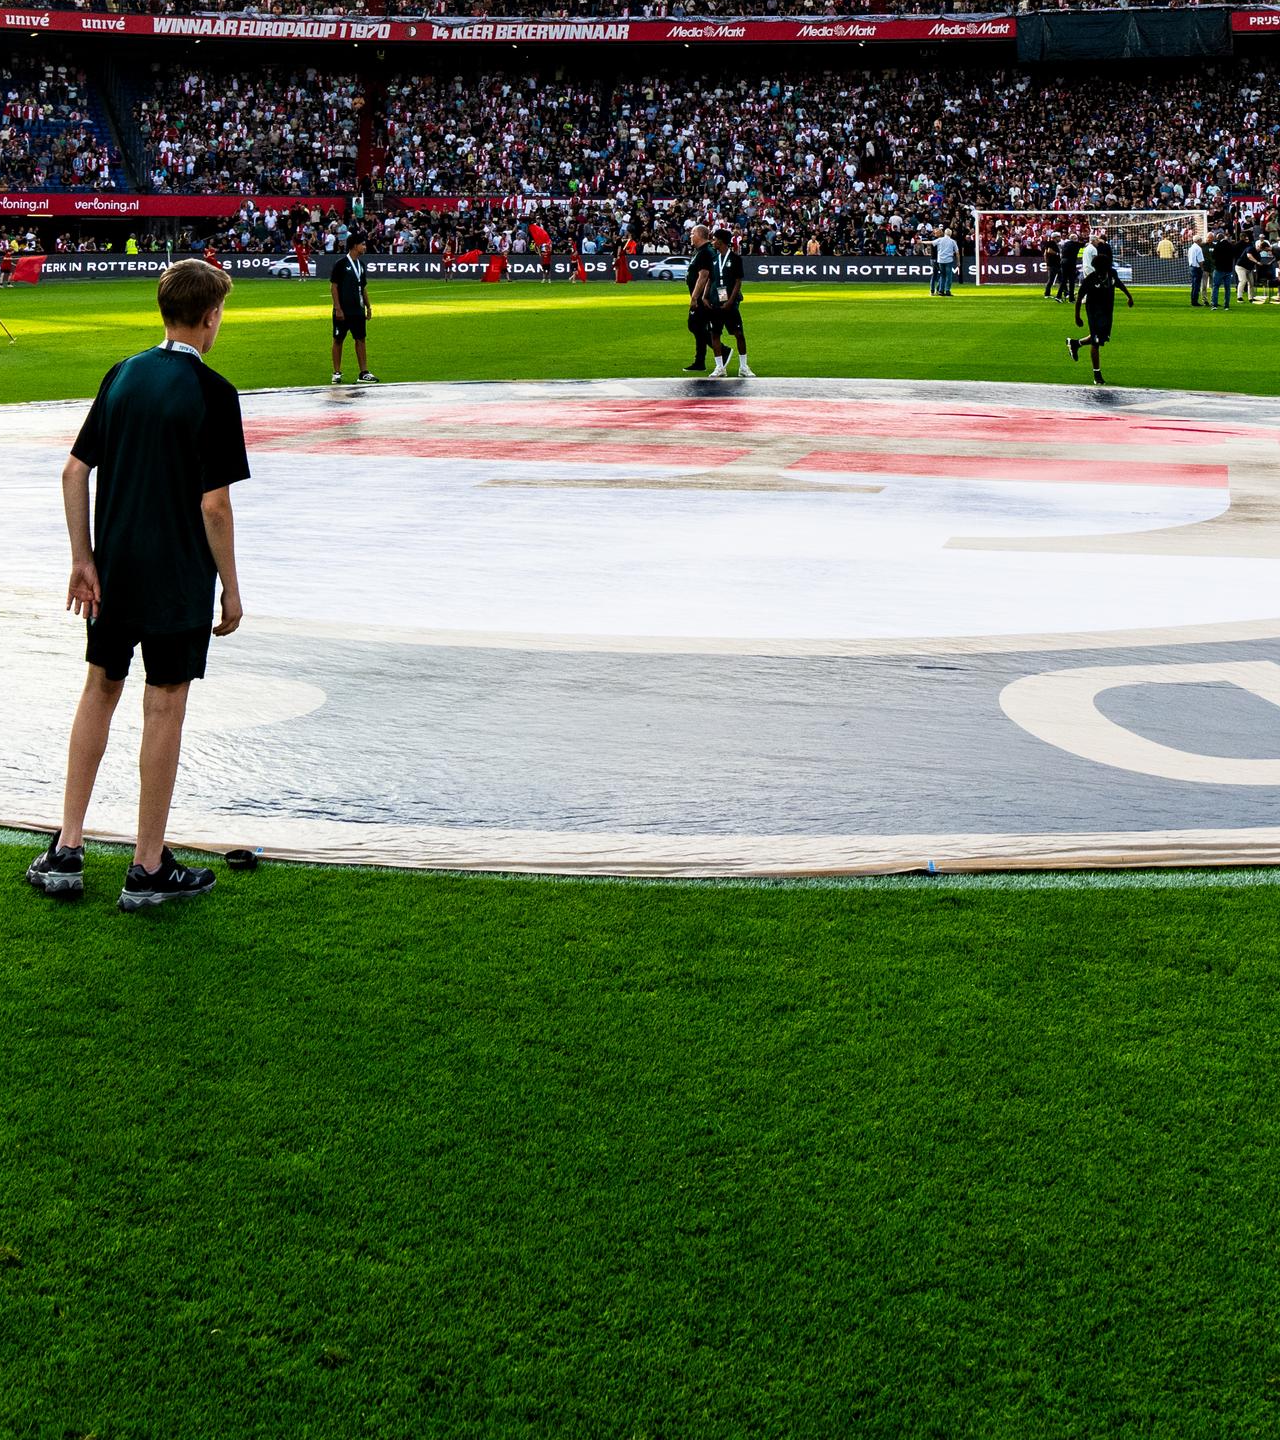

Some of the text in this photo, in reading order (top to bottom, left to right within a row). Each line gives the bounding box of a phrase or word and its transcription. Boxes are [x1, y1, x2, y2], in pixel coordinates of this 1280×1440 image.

[5, 13, 50, 27] univé
[82, 17, 126, 30] univé
[153, 17, 239, 36] WINNAAR
[238, 19, 337, 38] EUROPACUP
[349, 23, 391, 39] 1970
[431, 24, 630, 40] 14 KEER BEKERWINNAAR
[74, 197, 140, 213] verloning.nl
[69, 262, 82, 272] IN
[236, 258, 270, 269] 1908
[366, 262, 420, 273] STERK
[424, 262, 441, 273] IN
[554, 262, 607, 273] SIDS
[757, 264, 817, 275] STERK
[822, 264, 840, 275] IN
[846, 264, 960, 275] ROTTERDM
